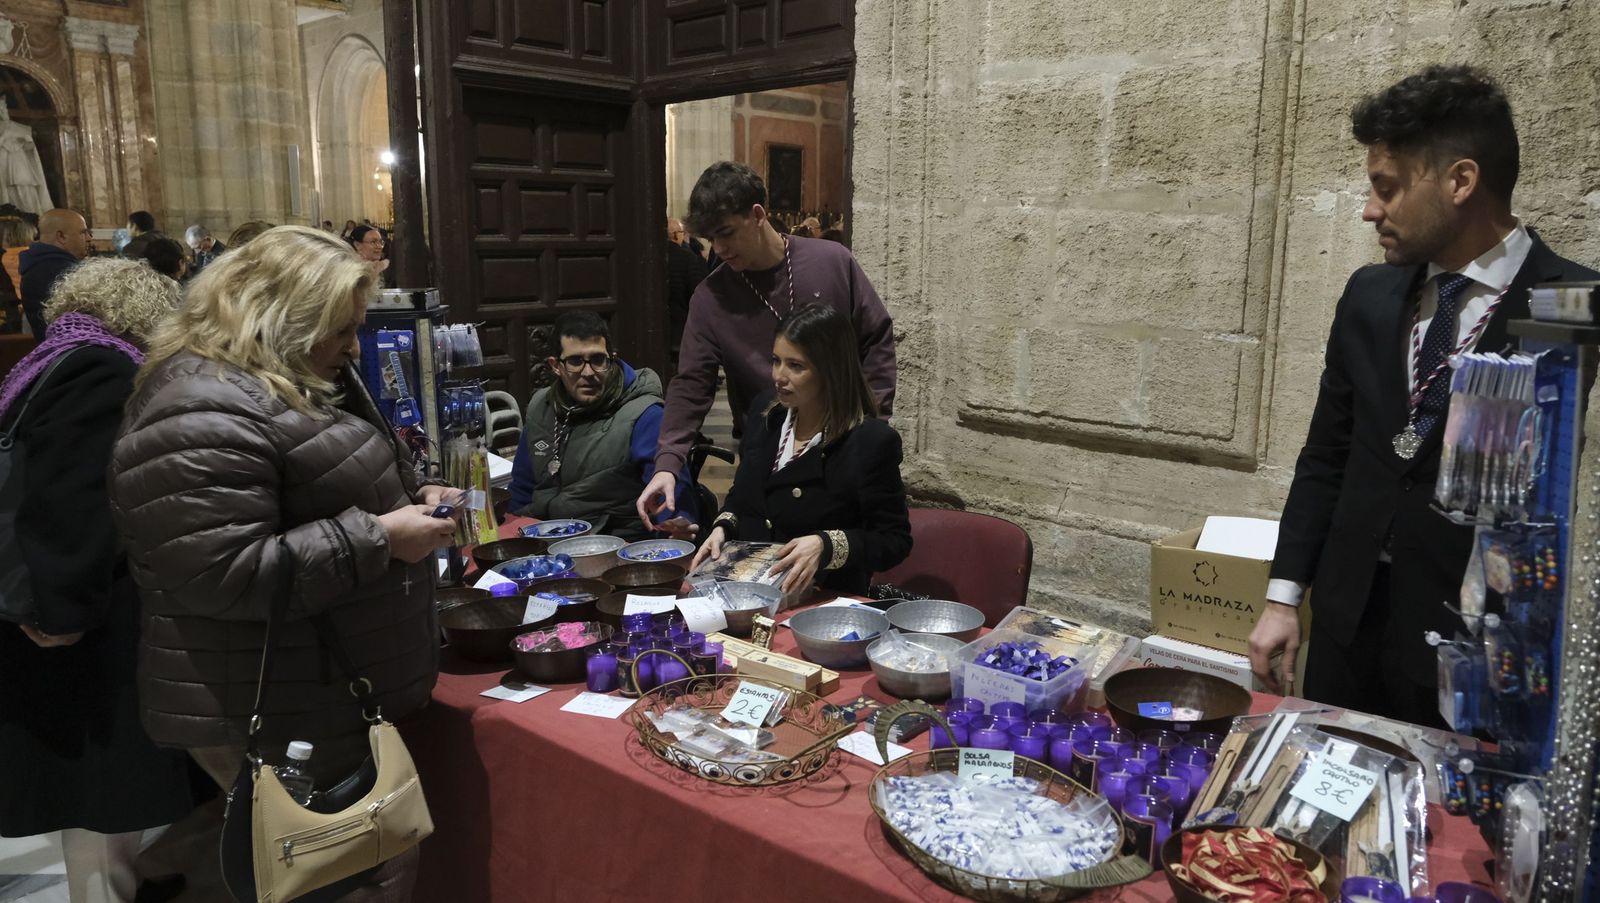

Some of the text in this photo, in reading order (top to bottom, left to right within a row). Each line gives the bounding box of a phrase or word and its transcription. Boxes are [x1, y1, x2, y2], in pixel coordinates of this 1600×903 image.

[1159, 587, 1254, 613] LA MADRAZA
[1149, 648, 1165, 656] VELAS
[1165, 651, 1173, 659] DE
[1173, 653, 1187, 662] CERA
[1187, 657, 1202, 666] PARA
[740, 687, 776, 702] ESTAMPAS
[964, 752, 990, 760] BOLSA
